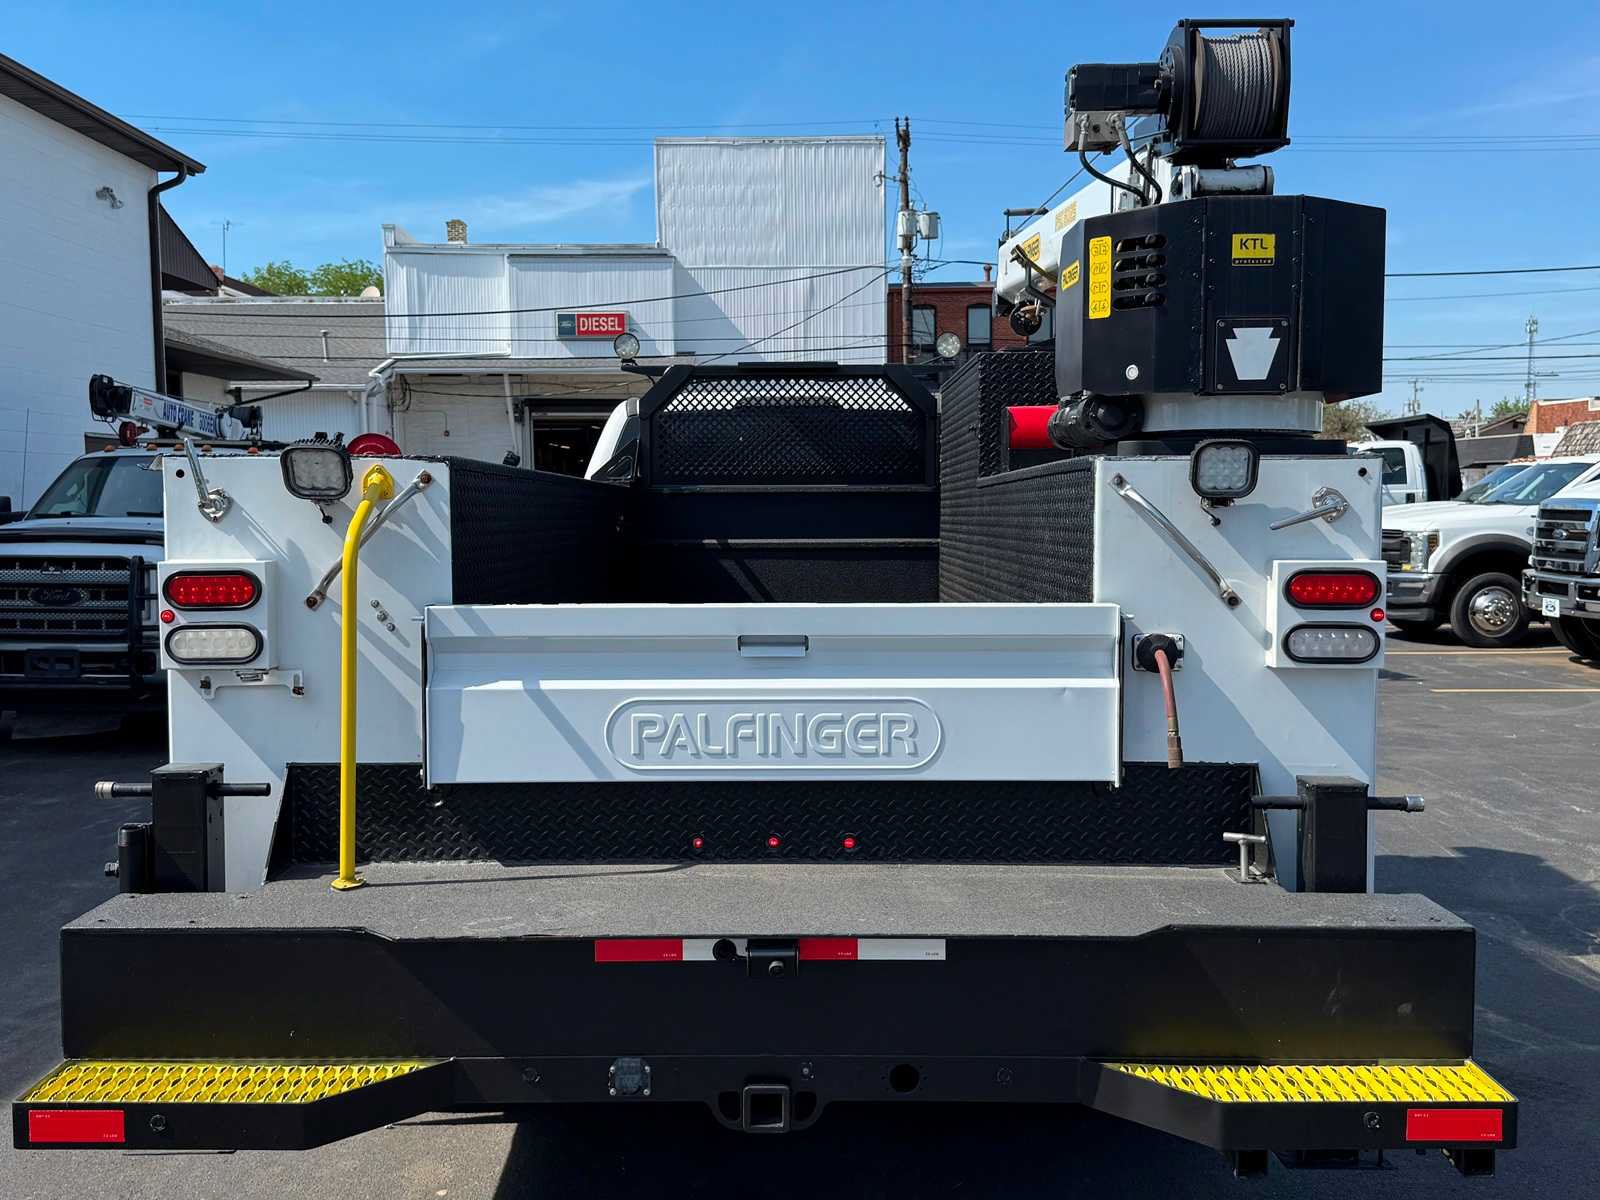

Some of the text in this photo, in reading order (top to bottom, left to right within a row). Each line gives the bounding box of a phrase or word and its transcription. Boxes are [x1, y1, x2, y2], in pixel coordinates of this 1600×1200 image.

[1240, 238, 1268, 250] KTL
[580, 317, 623, 331] DIESEL
[163, 402, 178, 423] AUTO
[630, 712, 919, 758] PALFINGER
